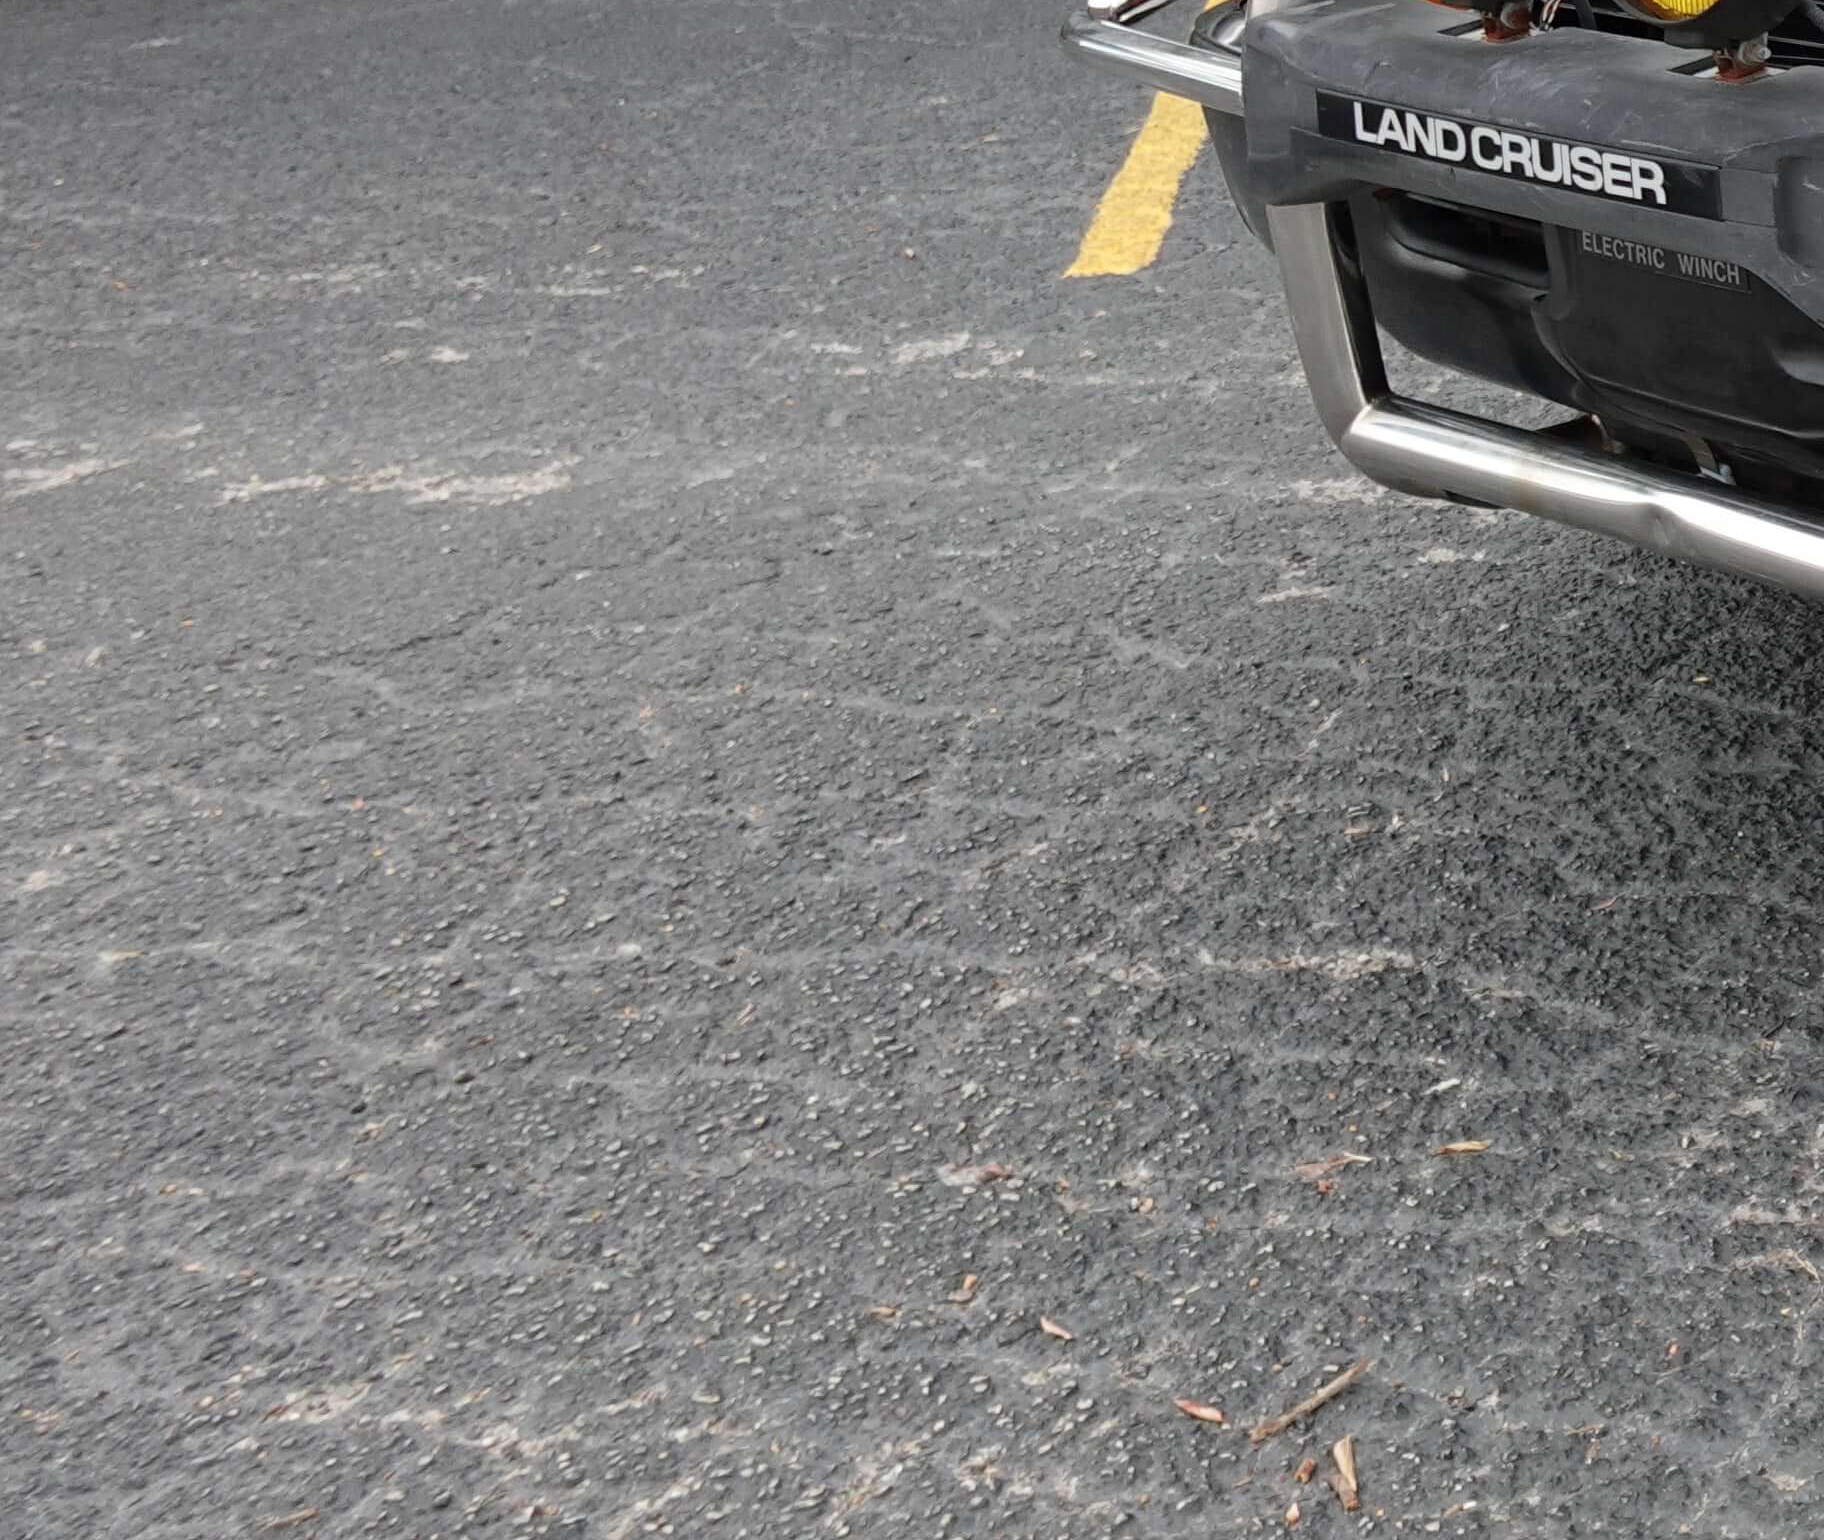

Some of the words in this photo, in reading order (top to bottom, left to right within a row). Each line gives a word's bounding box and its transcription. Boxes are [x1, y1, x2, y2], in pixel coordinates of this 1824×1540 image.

[1353, 101, 1467, 163] LAND
[1470, 126, 1667, 206] CRUISER
[1582, 231, 1666, 271] ELECTRIC
[1677, 252, 1741, 286] WINCH
